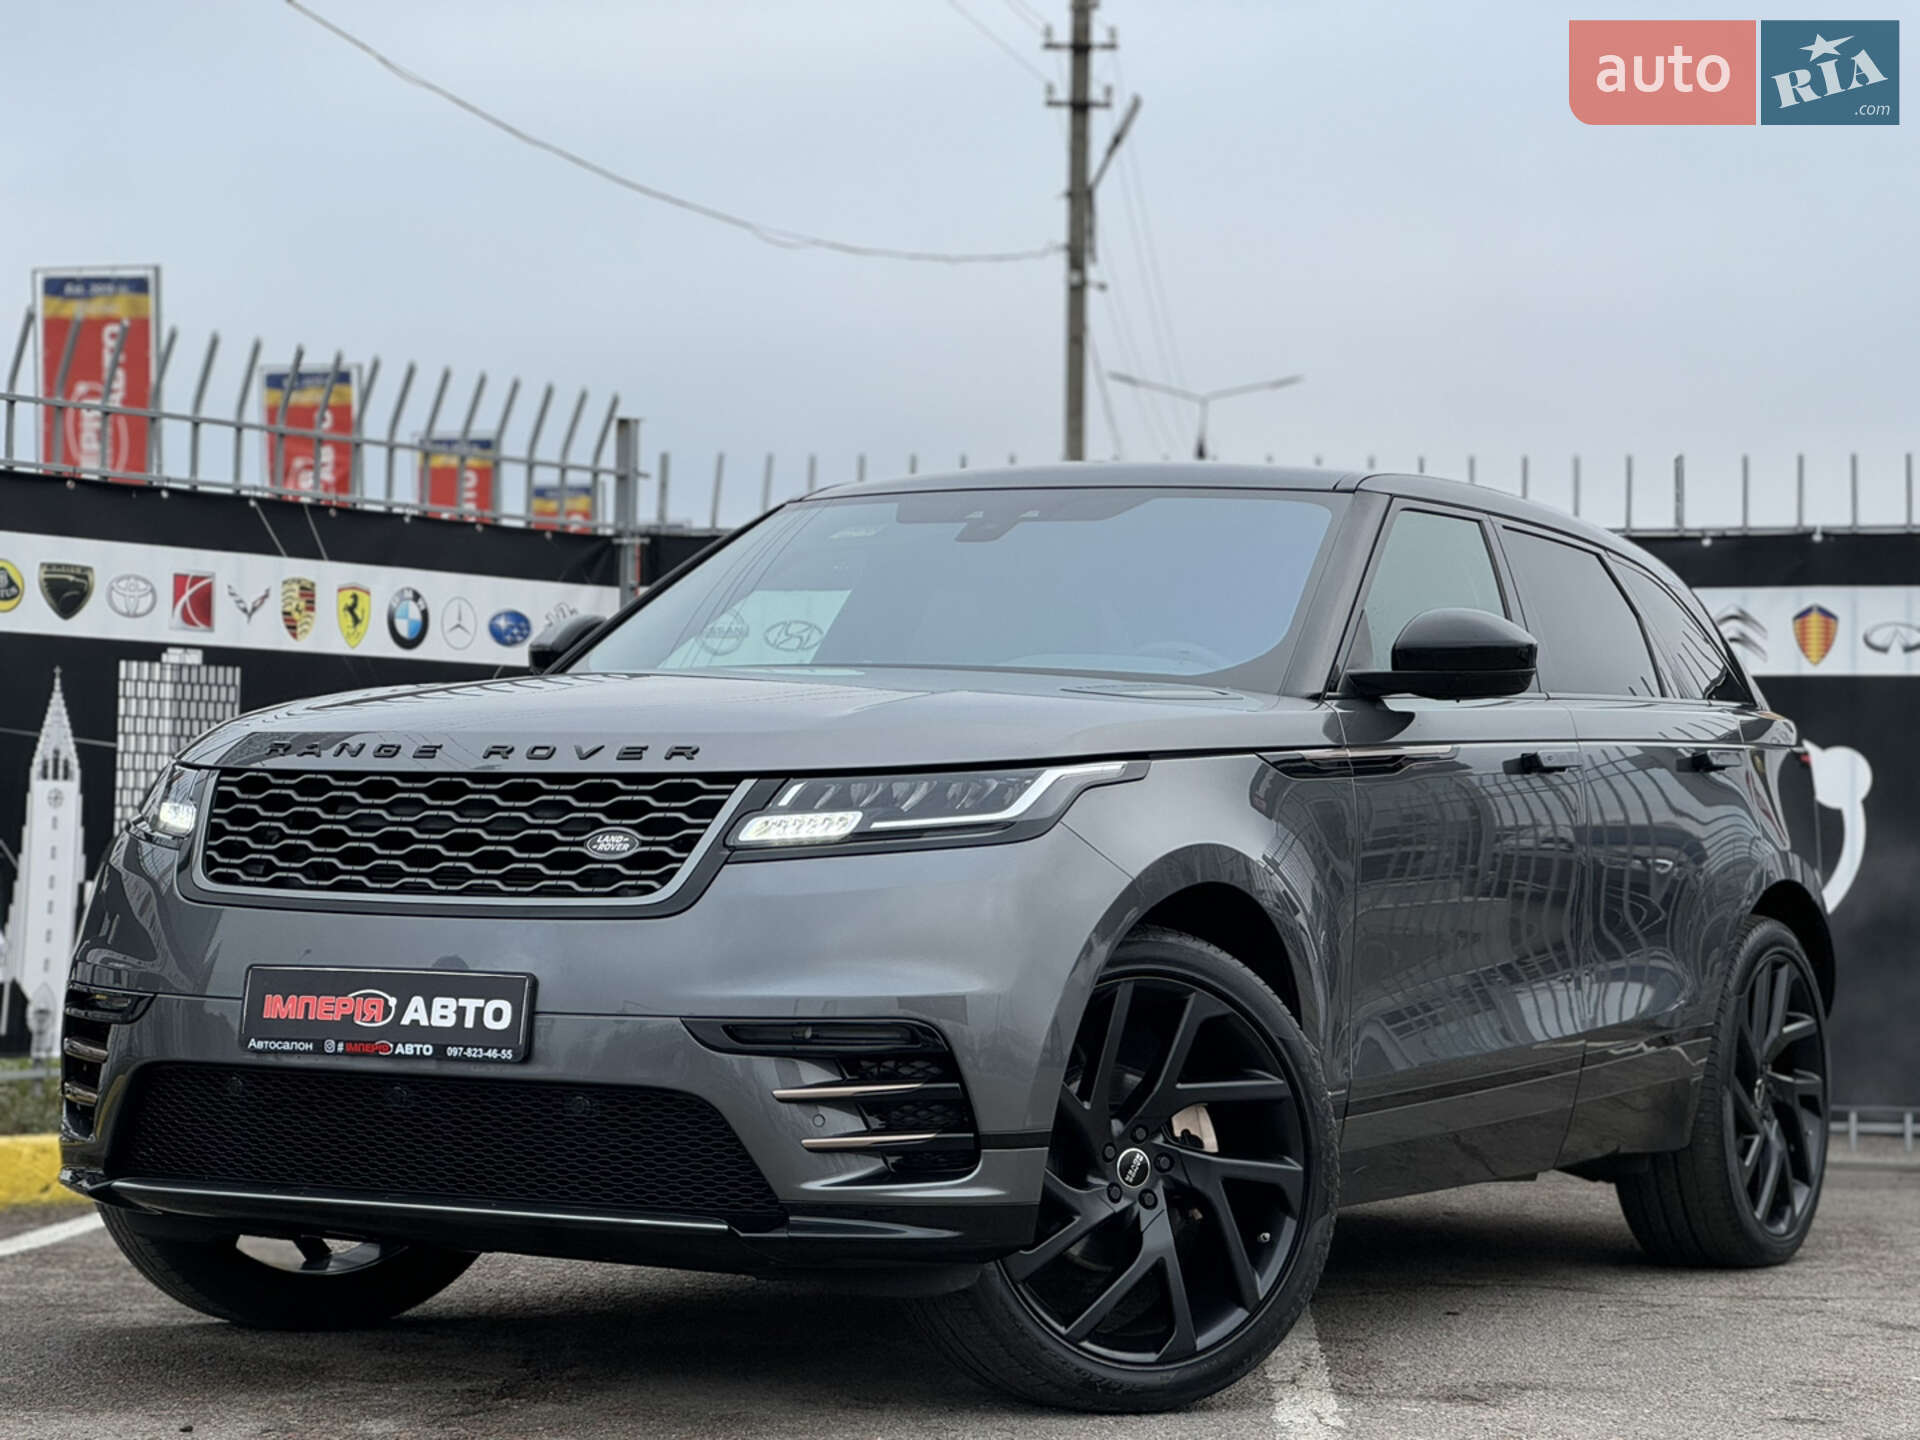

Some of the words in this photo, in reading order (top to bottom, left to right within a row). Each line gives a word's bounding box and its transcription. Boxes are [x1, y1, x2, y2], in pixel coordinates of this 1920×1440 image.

[265, 742, 443, 759] RANGE
[482, 745, 700, 760] ROVER
[263, 994, 385, 1022] ІМПЕРІЯ
[400, 995, 512, 1030] АВТО
[248, 1038, 313, 1051] Автосалон
[395, 1044, 433, 1056] АВТО
[446, 1046, 513, 1060] 097-823-46-55
